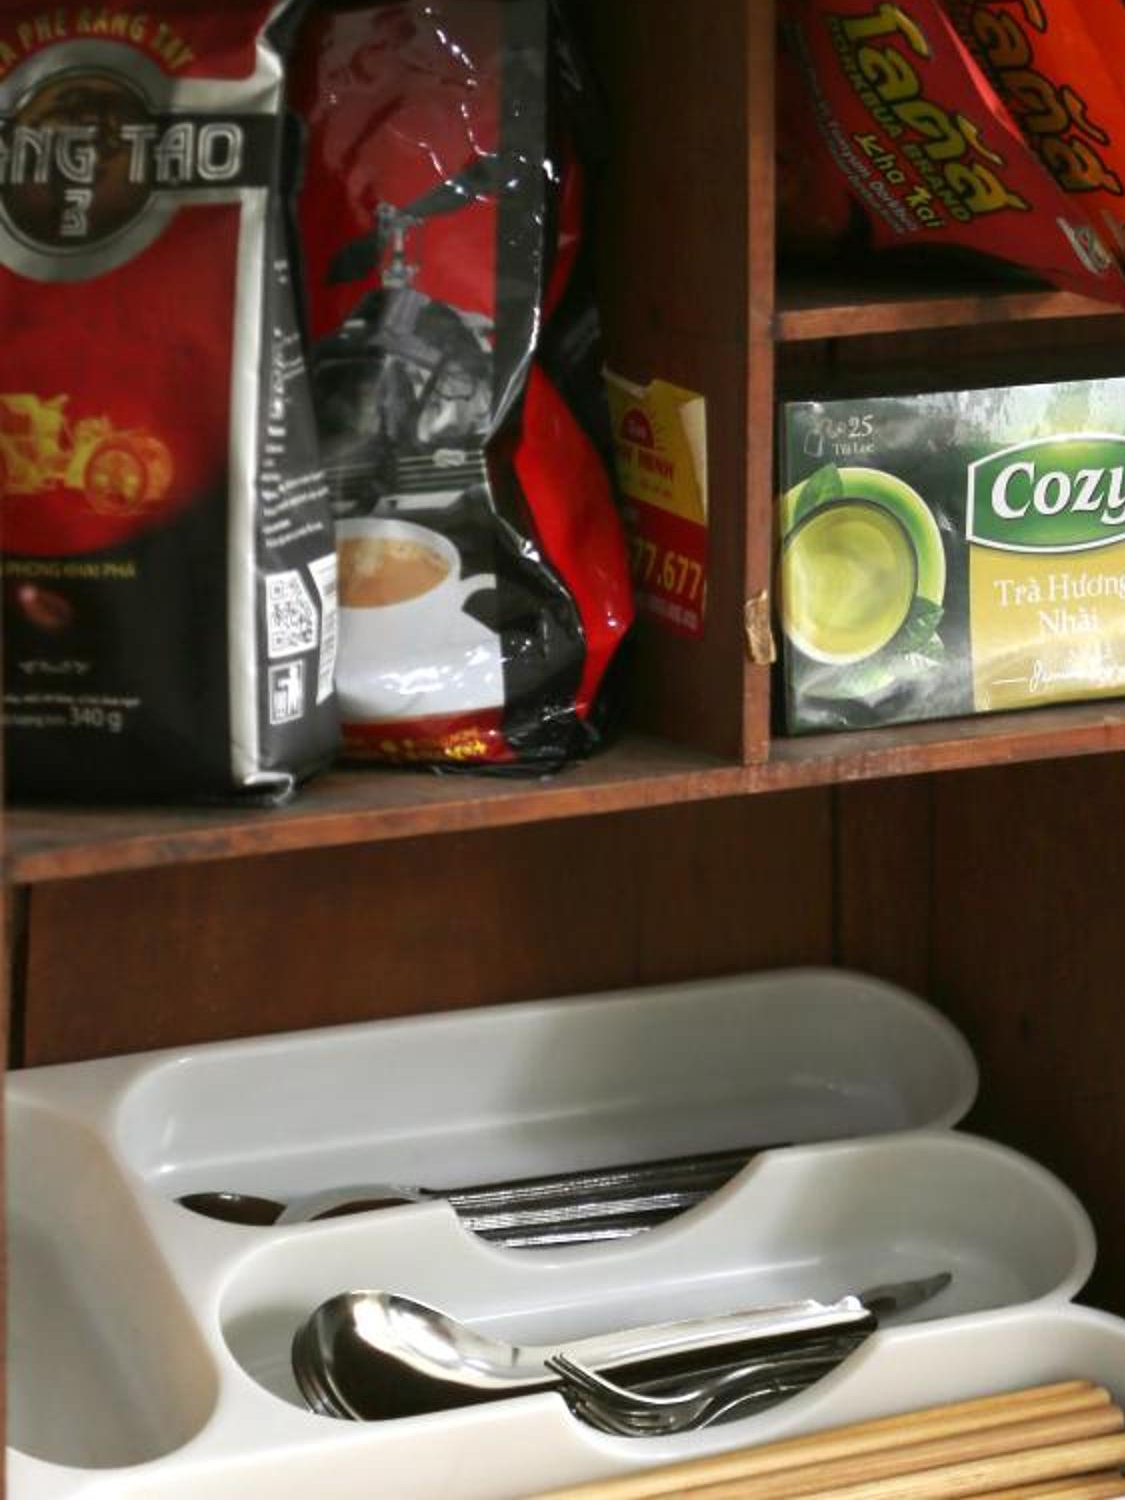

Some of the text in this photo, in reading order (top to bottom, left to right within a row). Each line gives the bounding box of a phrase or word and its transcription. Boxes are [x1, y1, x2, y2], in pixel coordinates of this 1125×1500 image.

[842, 2, 1032, 214] โลตัส
[59, 188, 93, 236] 3
[847, 414, 874, 439] 25
[993, 576, 1041, 608] Trà
